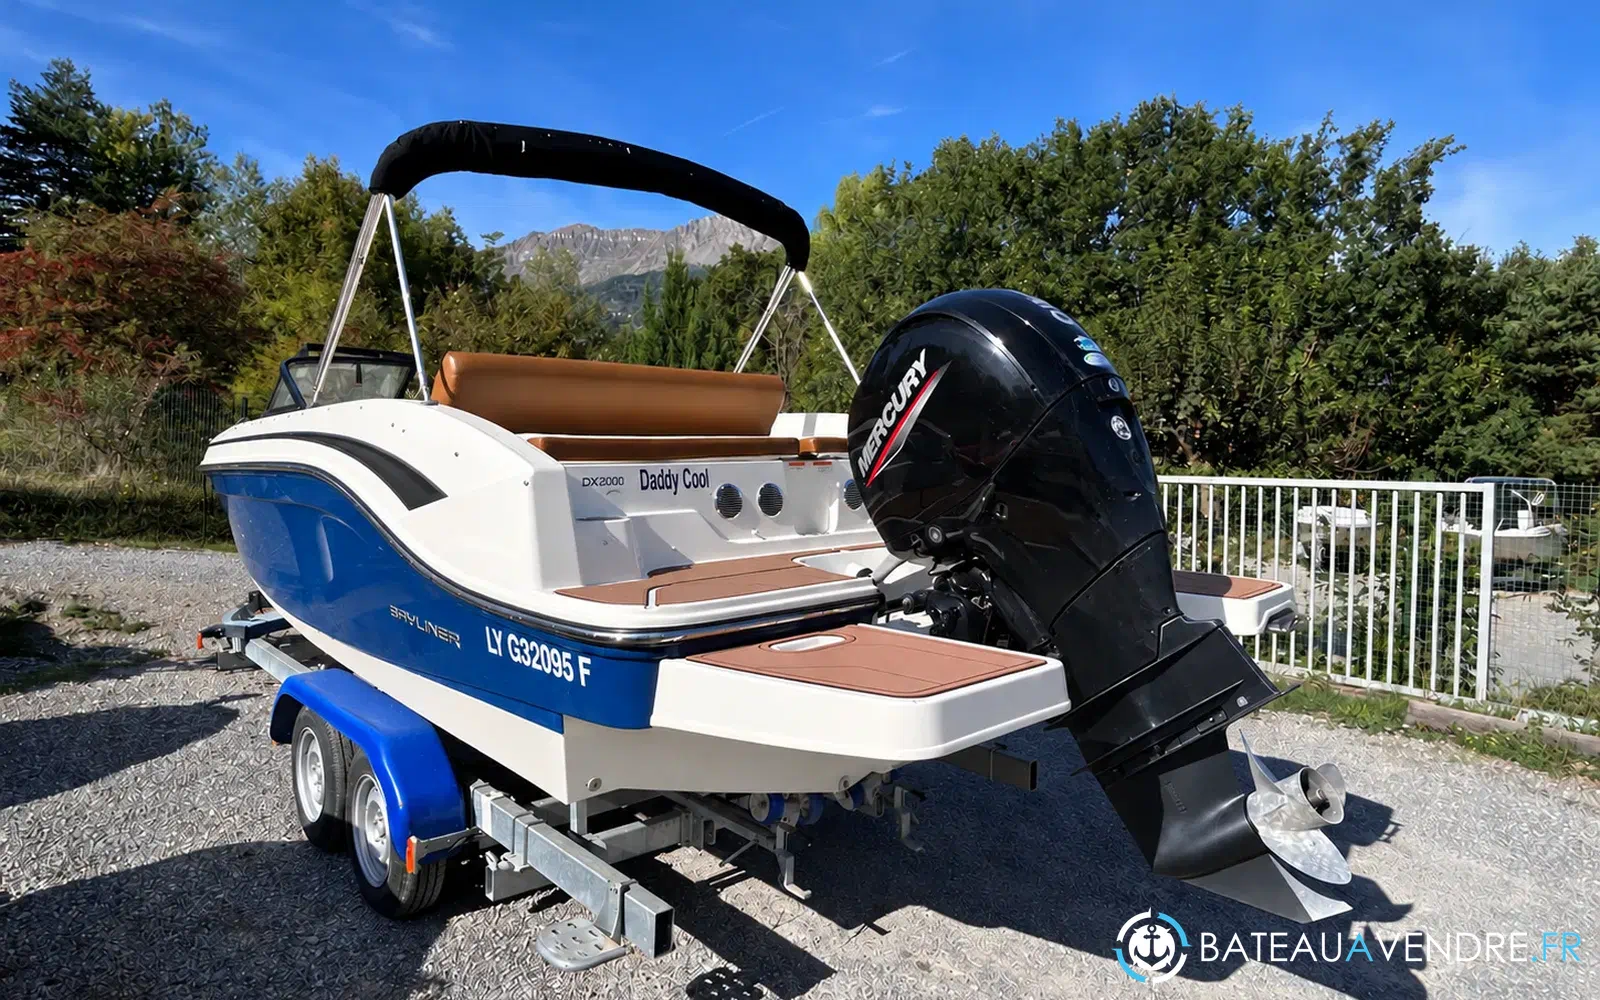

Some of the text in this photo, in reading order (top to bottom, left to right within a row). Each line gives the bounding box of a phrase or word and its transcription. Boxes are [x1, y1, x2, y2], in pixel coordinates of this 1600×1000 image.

[857, 348, 928, 478] MERCURY
[581, 475, 625, 487] DX2000
[639, 467, 710, 496] Daddy Cool
[389, 604, 461, 649] BAYLINER
[485, 626, 591, 687] LY G32095 F
